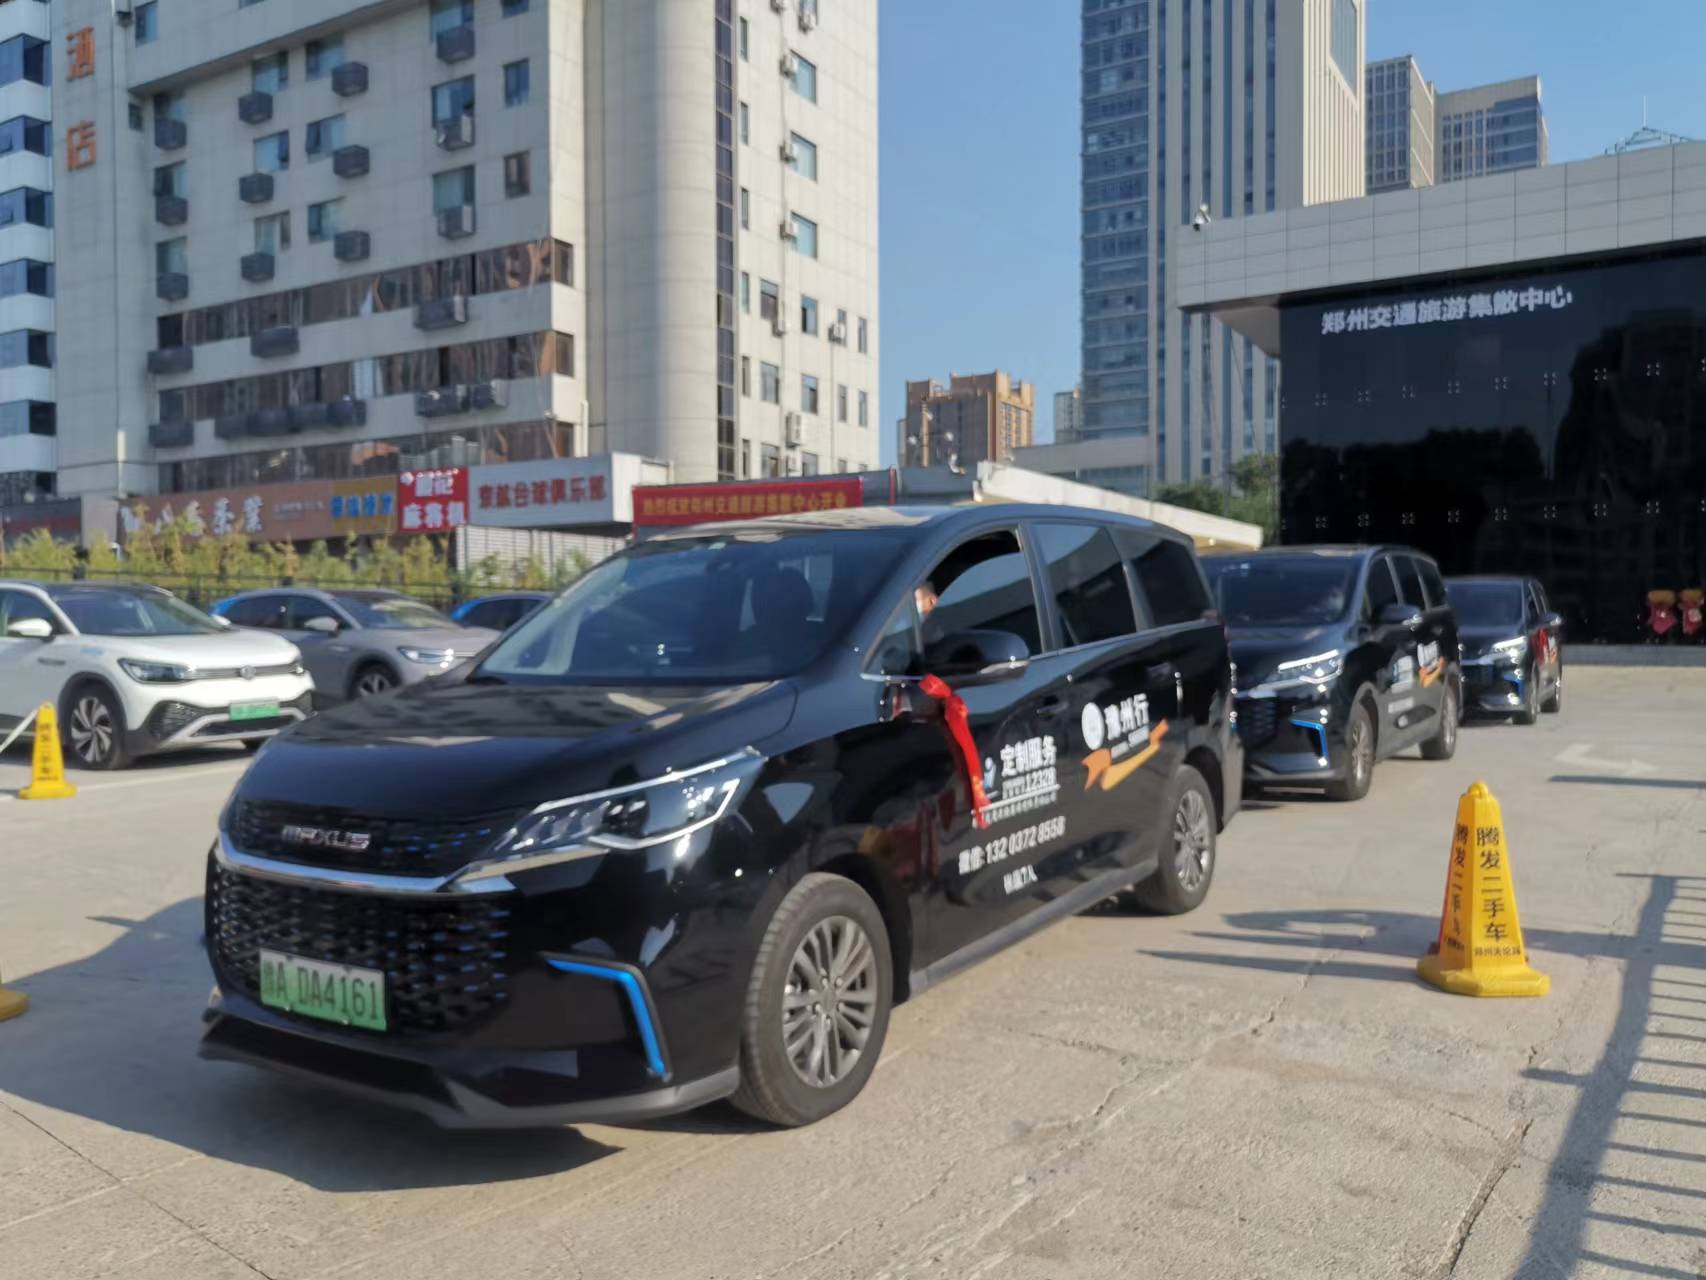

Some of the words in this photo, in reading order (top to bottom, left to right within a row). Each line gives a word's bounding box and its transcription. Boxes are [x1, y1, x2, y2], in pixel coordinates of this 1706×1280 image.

[66, 27, 96, 171] 酒店
[1321, 285, 1573, 335] 郑州交通旅游集散中心
[1000, 735, 1057, 777] 定制服务
[985, 836, 1008, 864] 132
[1476, 827, 1508, 943] 腾发二手车
